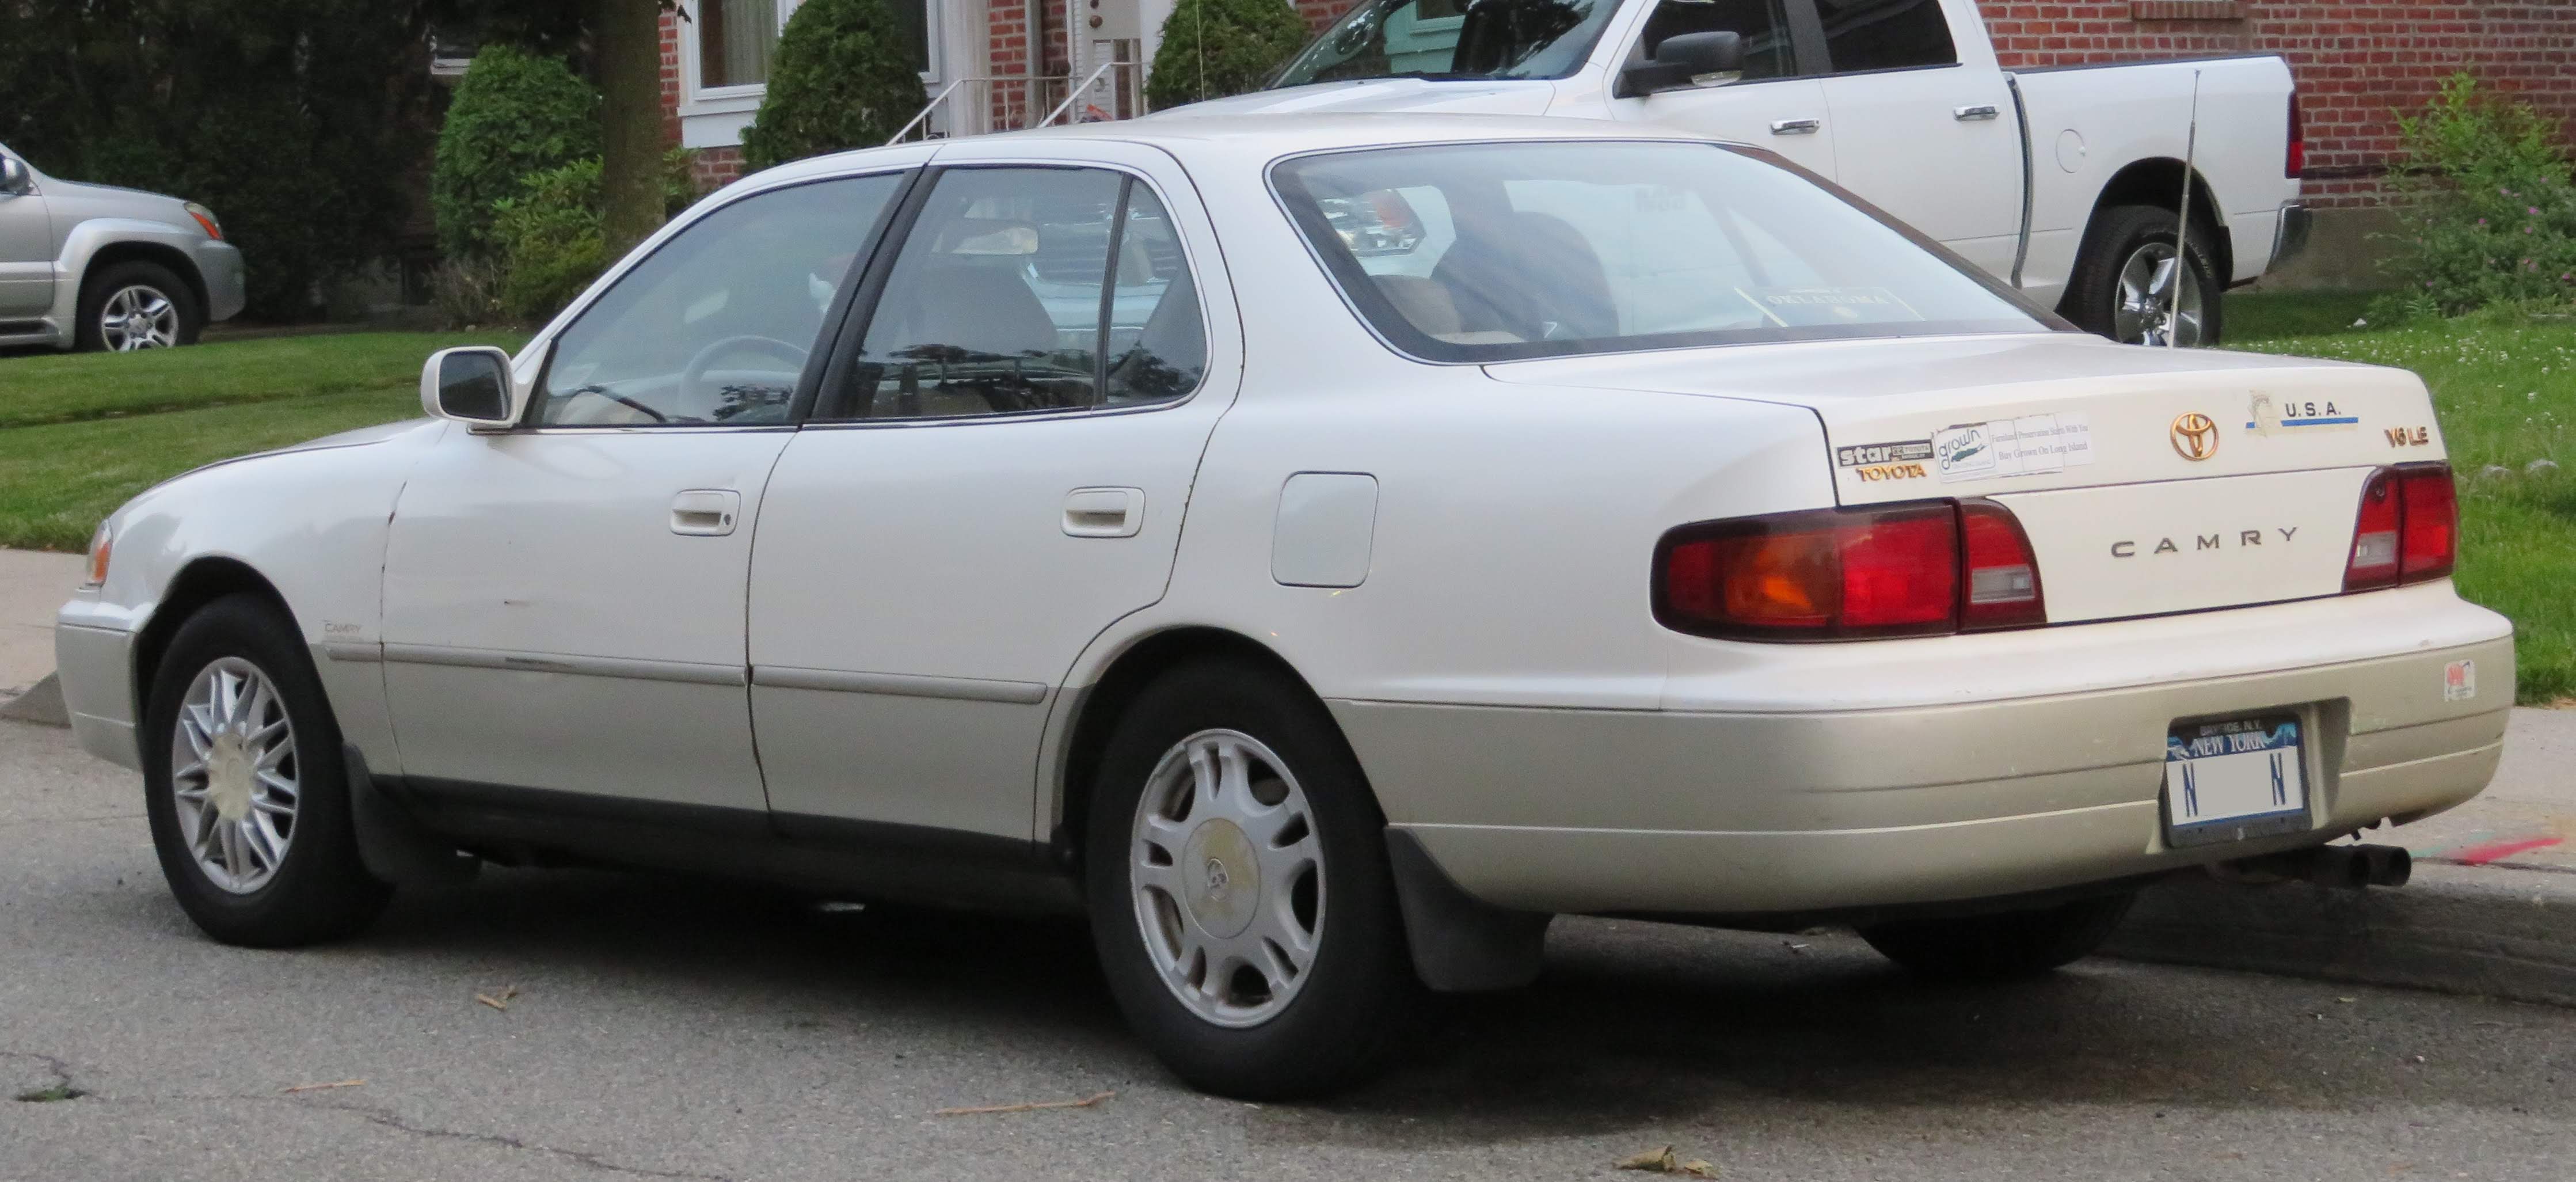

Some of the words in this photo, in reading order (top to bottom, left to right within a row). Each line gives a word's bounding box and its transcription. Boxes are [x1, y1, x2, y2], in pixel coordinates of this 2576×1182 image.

[1938, 428, 1981, 470] grown
[2384, 427, 2407, 449] V6
[2407, 426, 2429, 447] LE
[1999, 451, 2012, 461] Buy
[2014, 449, 2038, 459] Grown
[2038, 446, 2049, 455] On
[2050, 444, 2068, 454] Long
[2068, 441, 2088, 452] Island
[1855, 463, 1928, 482] TOYOTA
[2111, 527, 2297, 557] CAMRY
[325, 622, 363, 633] CAMRY
[2191, 735, 2224, 757] NEW
[2226, 731, 2266, 752] YORK
